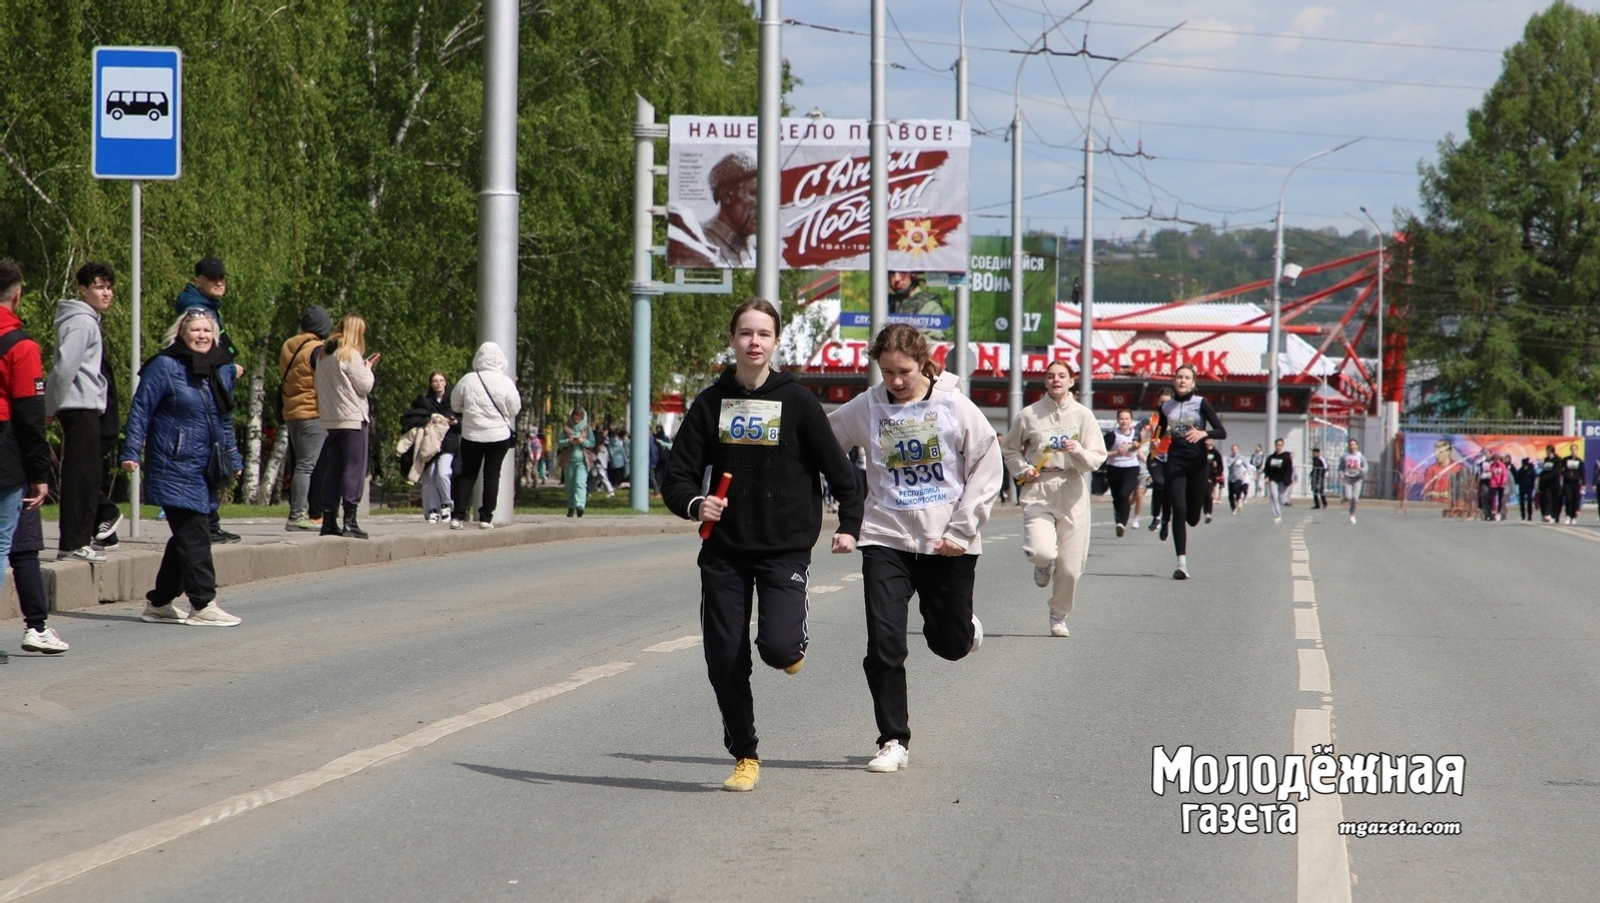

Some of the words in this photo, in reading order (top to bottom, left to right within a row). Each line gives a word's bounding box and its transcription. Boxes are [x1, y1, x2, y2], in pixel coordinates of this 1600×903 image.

[689, 122, 757, 138] НАШЕ
[780, 124, 835, 140] ЕЛО
[850, 124, 952, 140] ПВОЕ!
[786, 176, 934, 254] Побеы!
[730, 415, 764, 441] 65
[769, 428, 777, 440] 8
[895, 438, 924, 462] 19
[930, 447, 939, 458] 8
[888, 462, 945, 487] 1530
[895, 494, 947, 506] БАШКОРТОСТАН
[898, 486, 941, 497] РЕСПУБЛИКА
